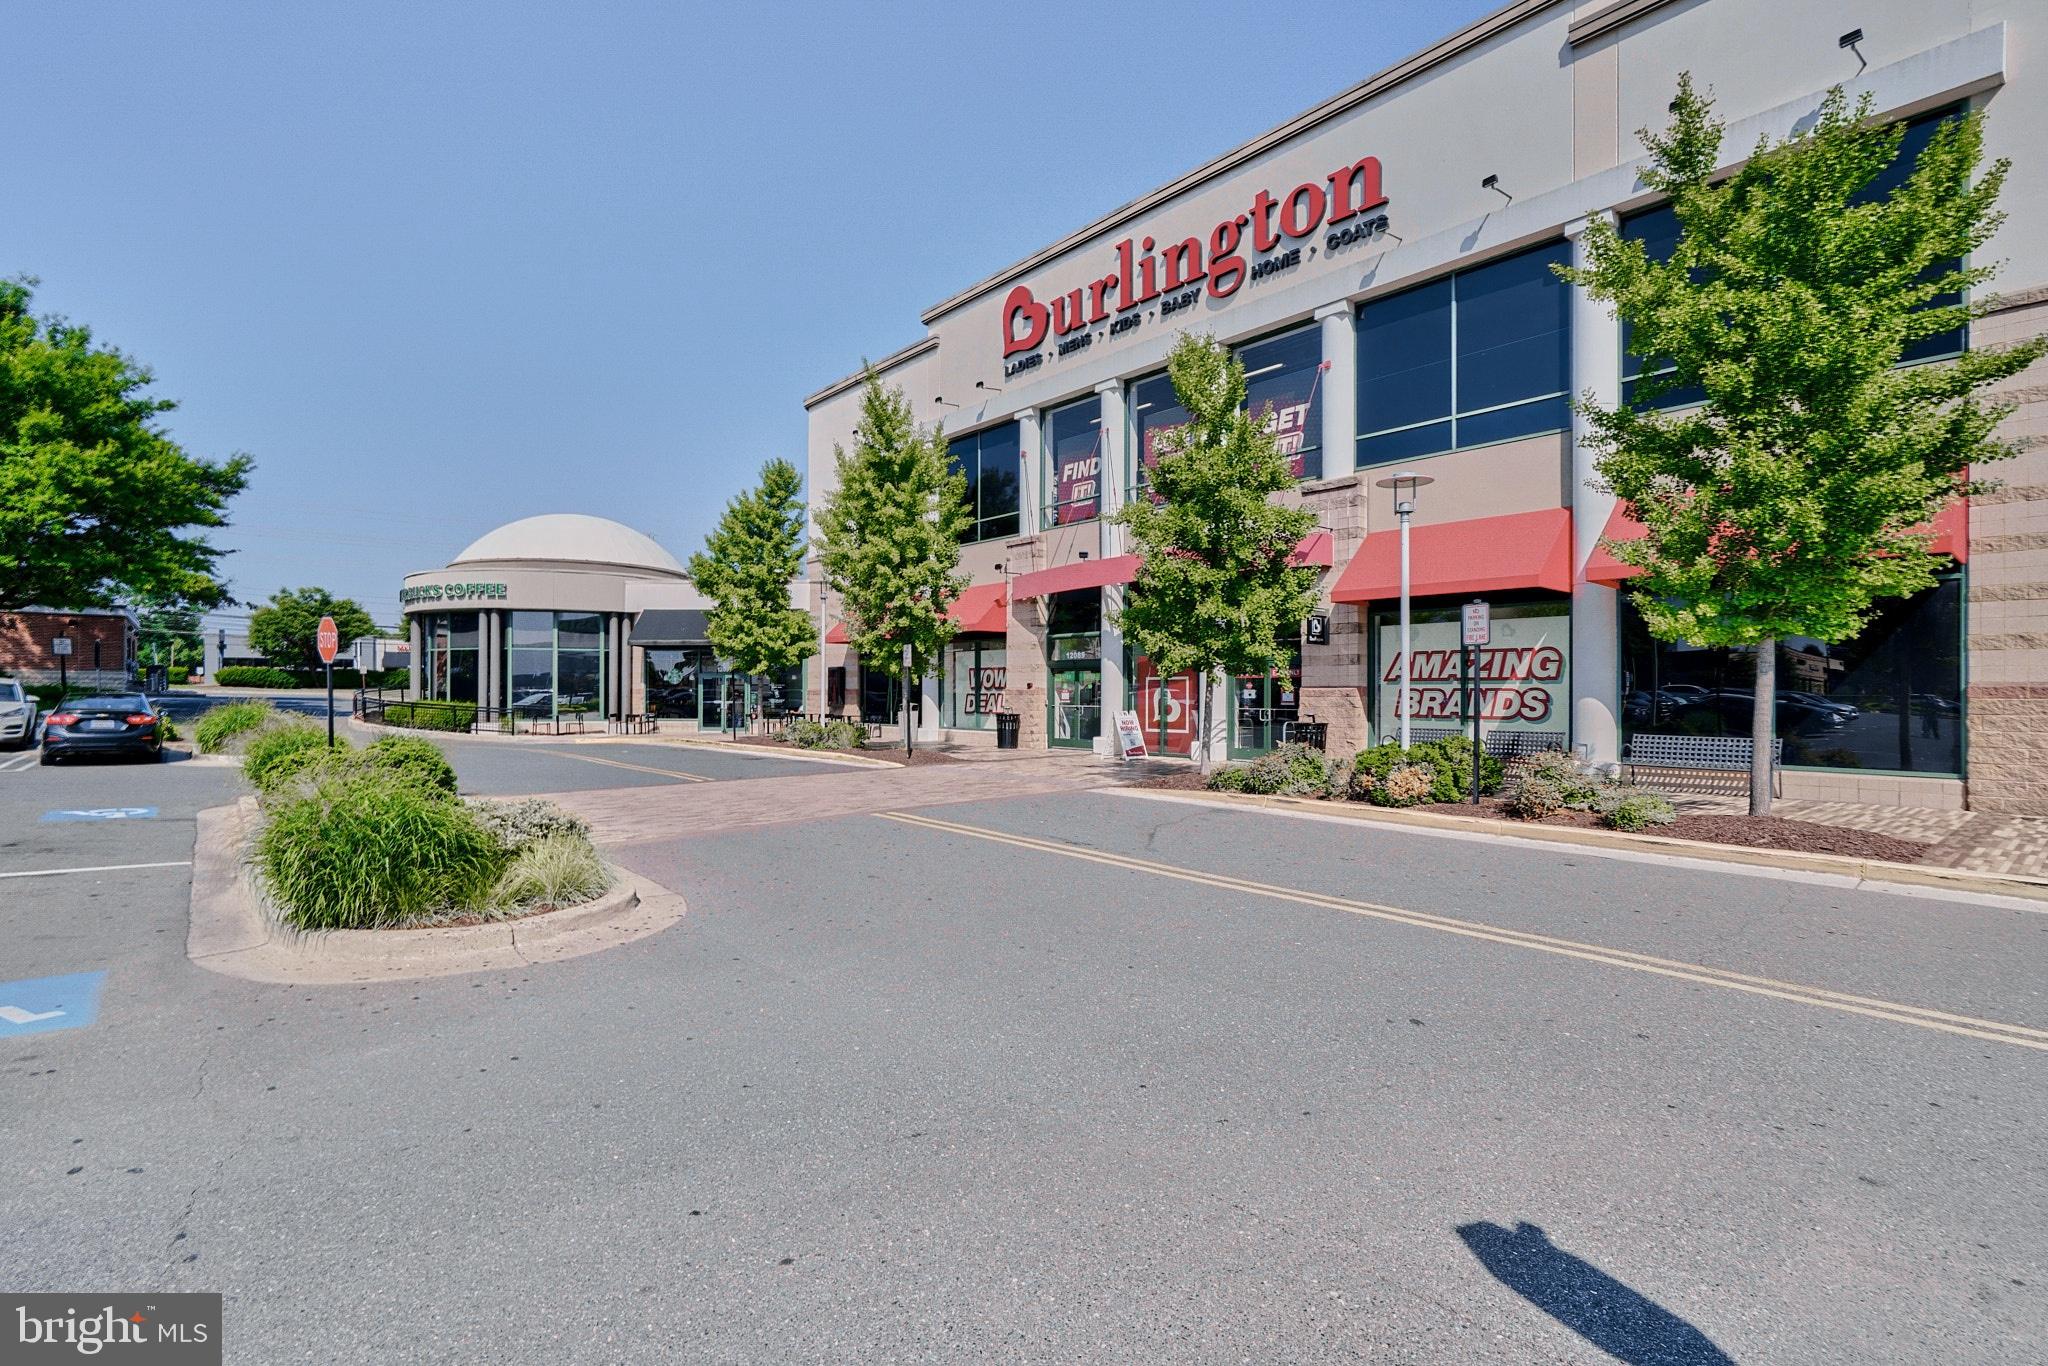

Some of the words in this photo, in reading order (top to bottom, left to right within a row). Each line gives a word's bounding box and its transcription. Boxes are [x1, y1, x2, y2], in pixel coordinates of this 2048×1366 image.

[1003, 156, 1388, 358] Burlington
[1005, 353, 1043, 377] LADIES
[1058, 332, 1092, 356] MENS
[1110, 313, 1141, 335] KIDS
[1161, 287, 1200, 315] BABY
[1251, 248, 1301, 280] HOME
[1327, 214, 1389, 250] COATS
[1063, 457, 1102, 482] FIND
[445, 583, 507, 598] COFFEE
[319, 632, 336, 648] STOP
[1384, 647, 1564, 682] AMAZING
[1395, 687, 1551, 721] BRANDS
